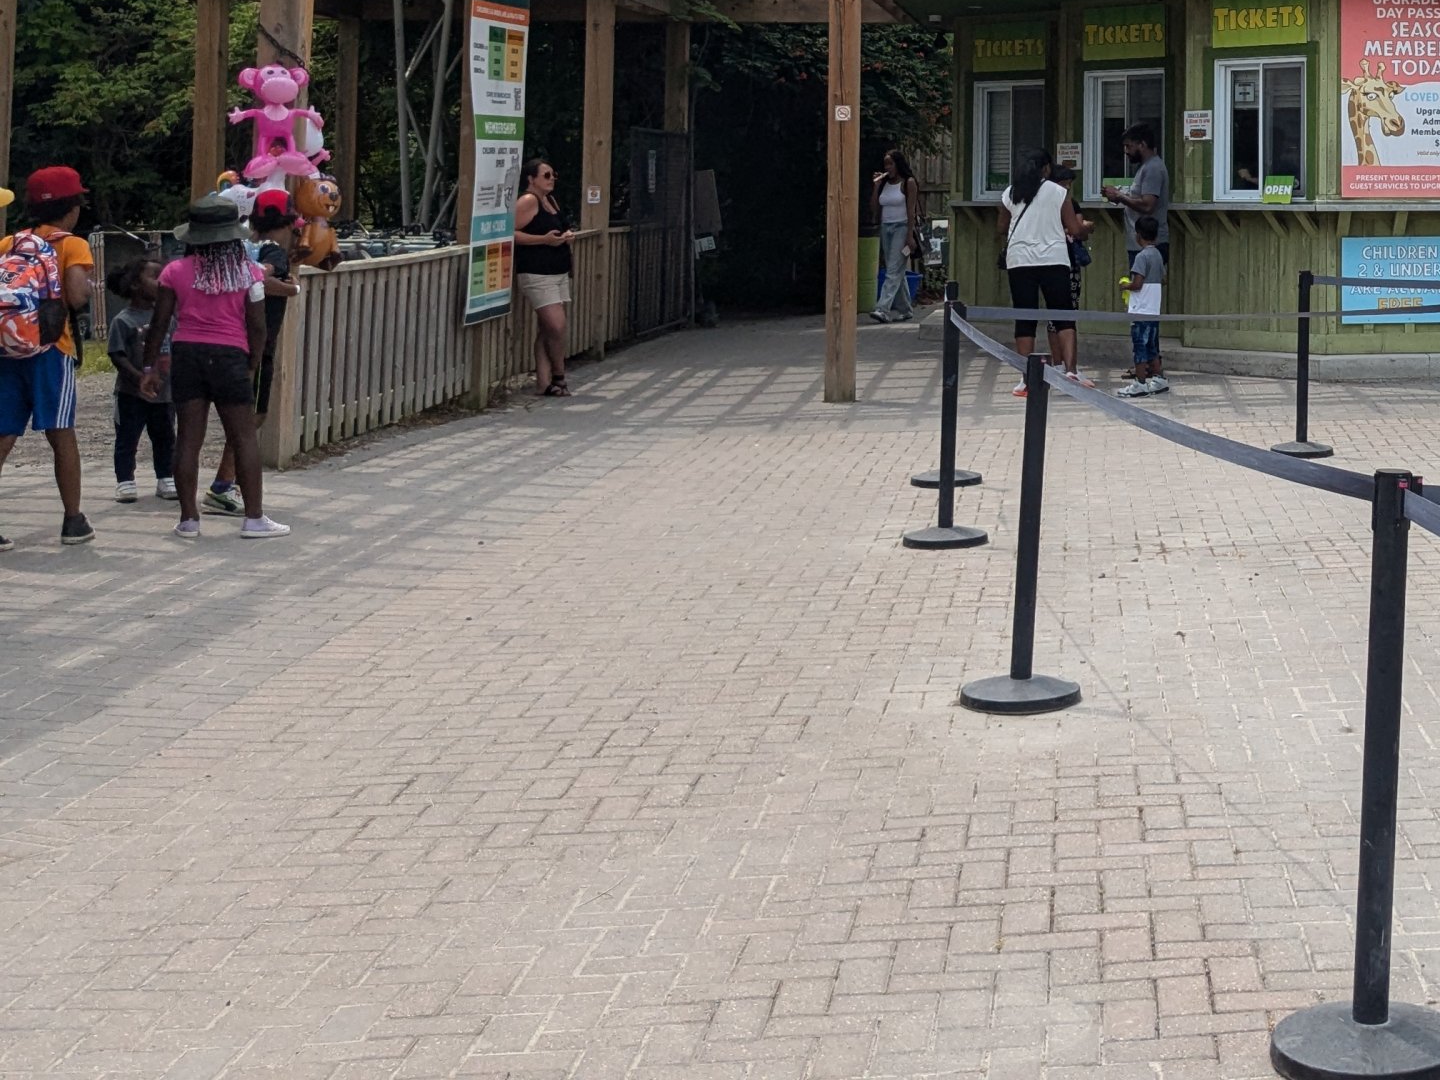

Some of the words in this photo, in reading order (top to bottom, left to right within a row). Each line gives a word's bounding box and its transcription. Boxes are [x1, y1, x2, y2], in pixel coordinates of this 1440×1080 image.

[1213, 5, 1306, 31] TICKETS
[1376, 8, 1406, 19] DAY
[1407, 8, 1440, 19] PASS
[1085, 23, 1164, 46] TICKETS
[974, 38, 1045, 58] TICKETS
[1405, 92, 1439, 102] LOVED
[1265, 185, 1292, 195] OPEN
[1362, 245, 1438, 259] CHILDREN
[1358, 263, 1367, 277] 2
[1373, 263, 1384, 277] &
[1350, 286, 1381, 295] ARE
